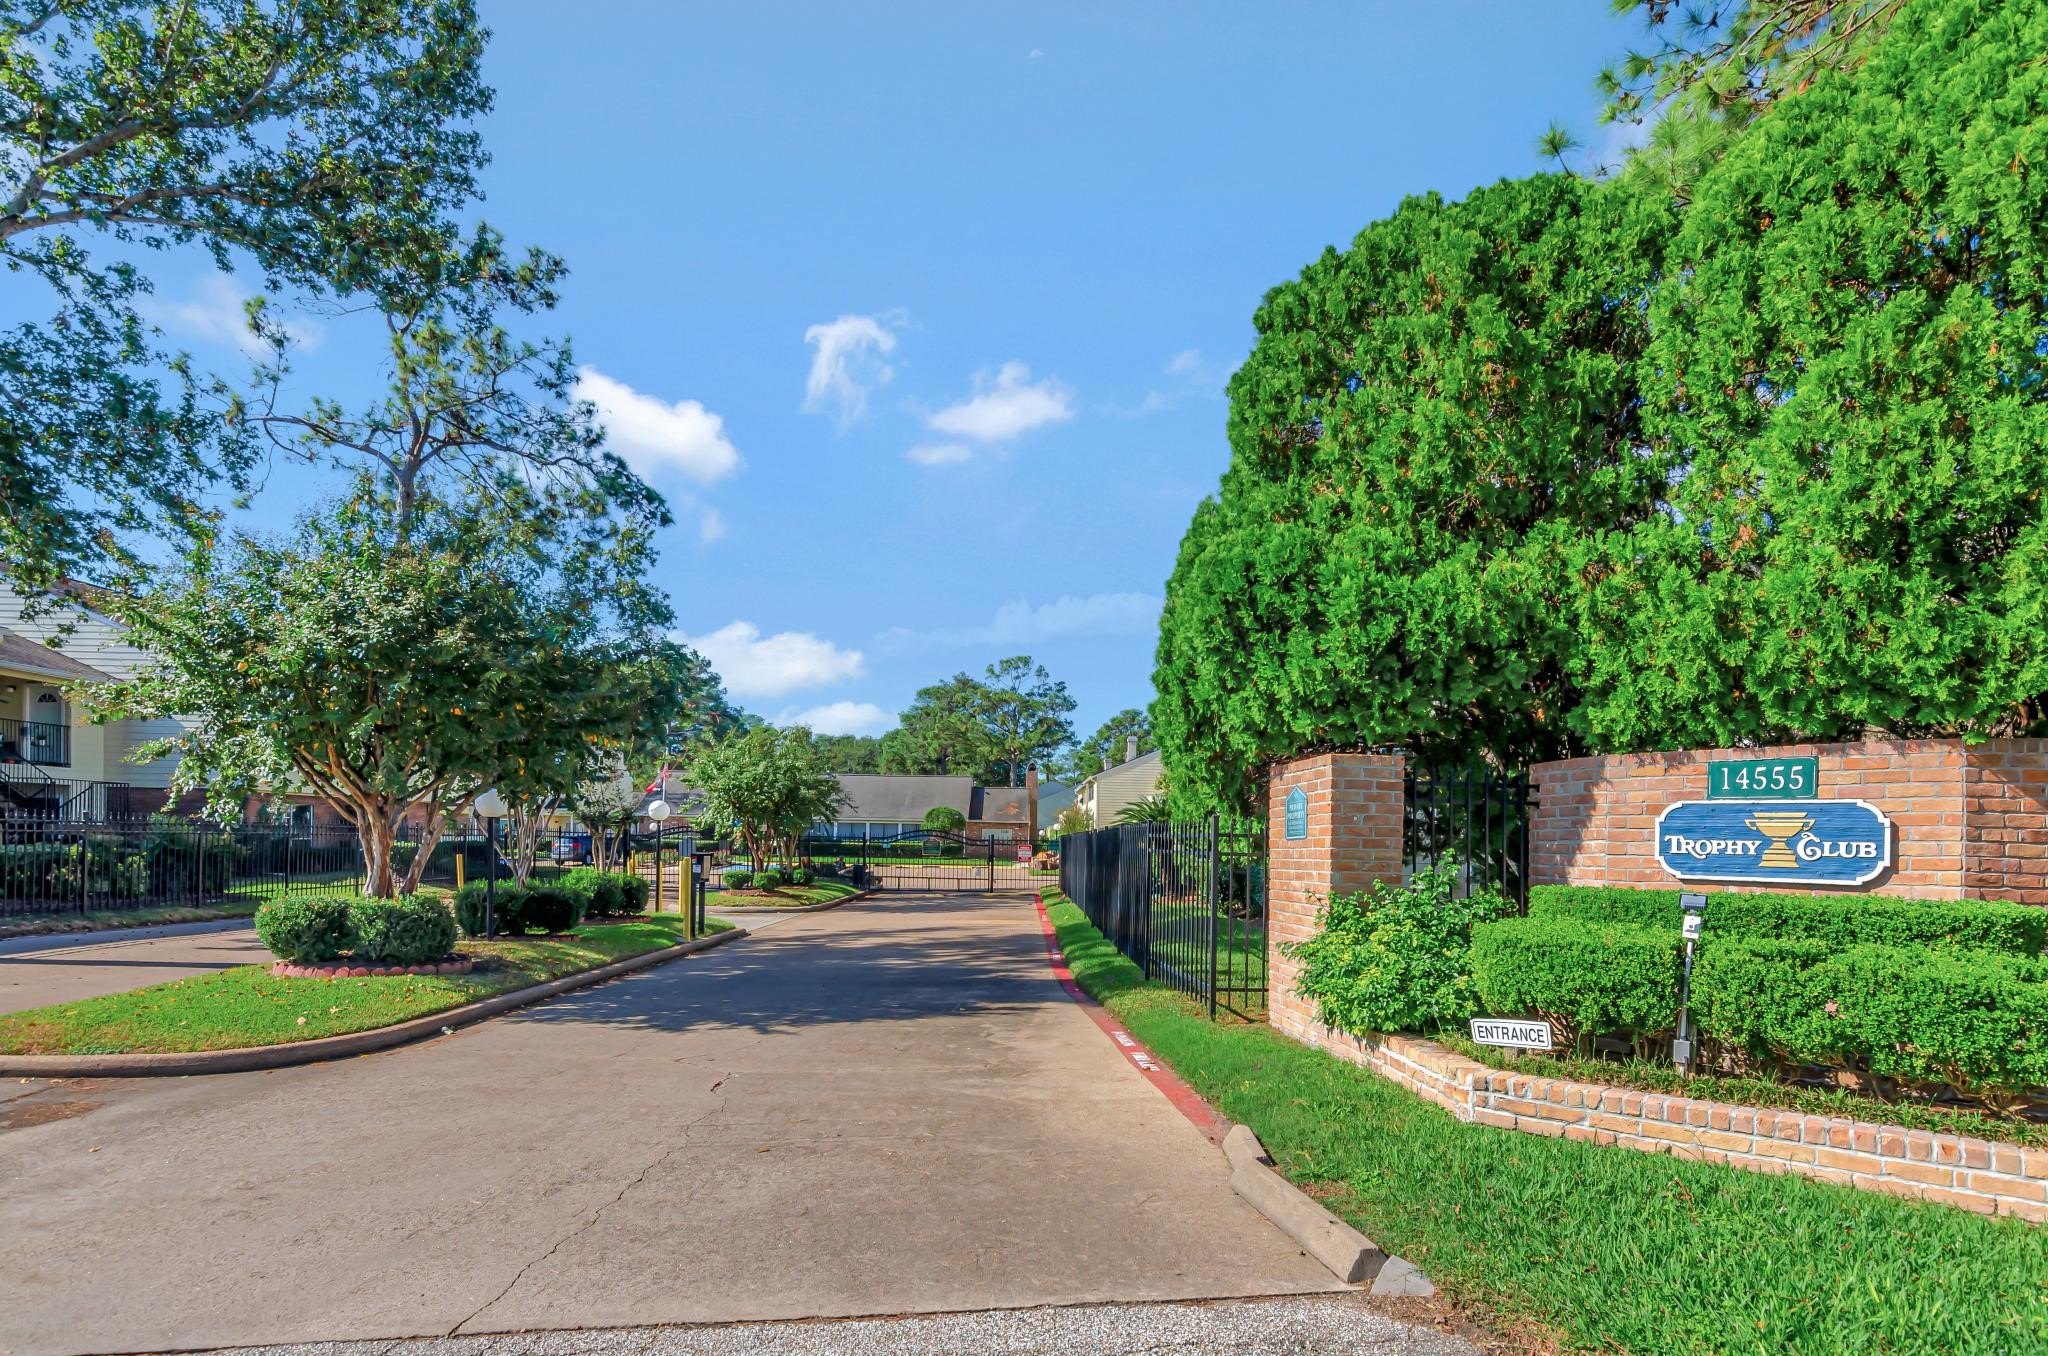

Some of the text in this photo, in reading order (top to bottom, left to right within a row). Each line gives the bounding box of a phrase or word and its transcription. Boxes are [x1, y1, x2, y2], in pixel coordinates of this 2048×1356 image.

[1721, 766, 1804, 790] 14555
[1665, 832, 1877, 861] TROPHY CLUB
[1477, 1025, 1545, 1043] ENTRANCE
